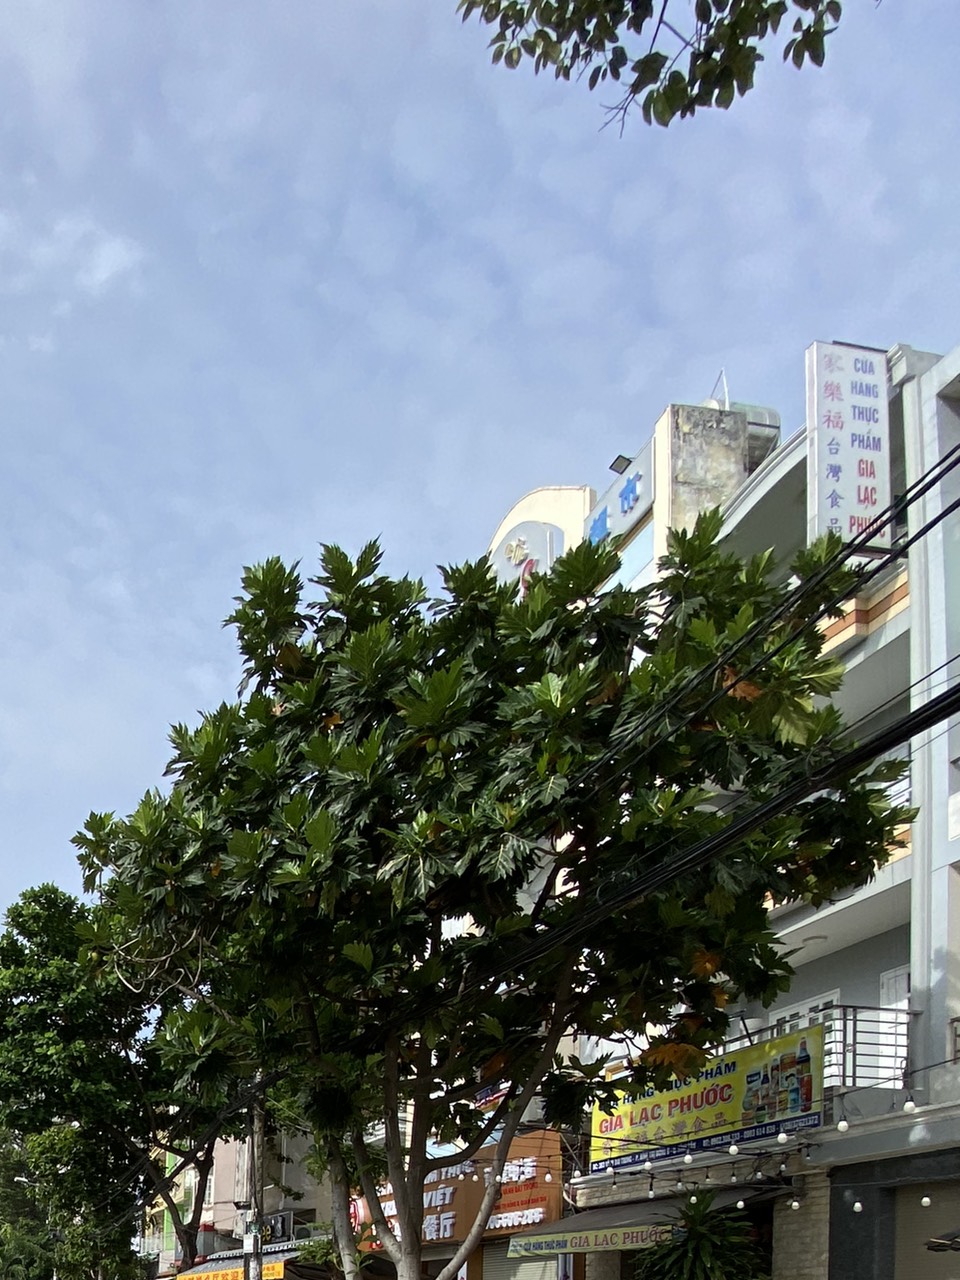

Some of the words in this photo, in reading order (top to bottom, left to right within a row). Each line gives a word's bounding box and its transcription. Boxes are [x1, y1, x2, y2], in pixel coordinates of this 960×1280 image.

[851, 404, 879, 426] THỰC
[858, 457, 876, 480] GIA
[857, 484, 877, 510] LẠC
[599, 1113, 623, 1134] GIA
[628, 1103, 662, 1127] LẠC
[668, 1081, 733, 1118] PHƯỚC
[570, 1235, 591, 1249] GIA
